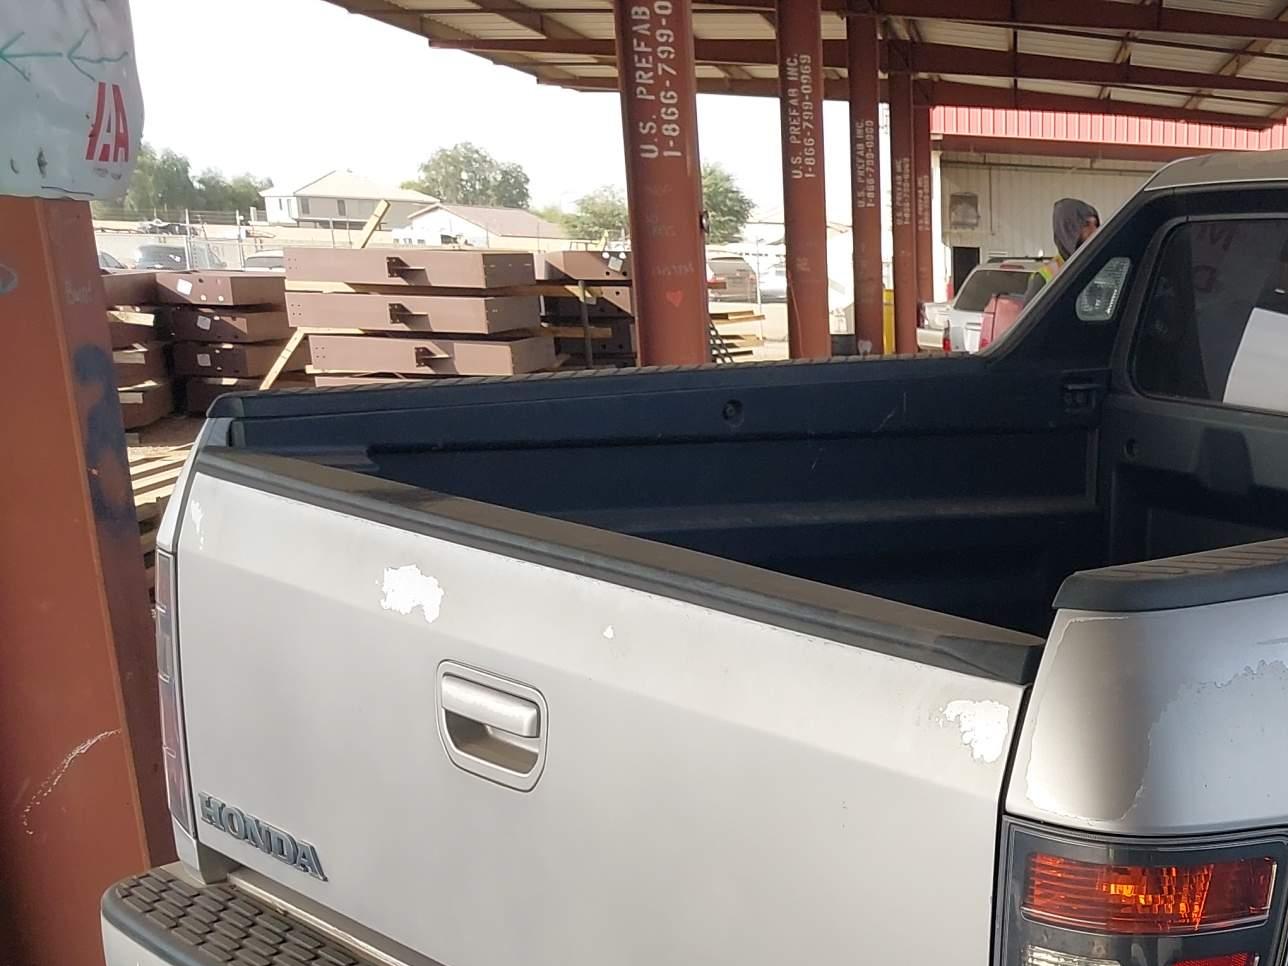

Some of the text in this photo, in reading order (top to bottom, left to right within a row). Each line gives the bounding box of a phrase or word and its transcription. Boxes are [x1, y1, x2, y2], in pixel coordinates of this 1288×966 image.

[631, 6, 656, 100] PREFAB
[638, 114, 659, 158] U.S.
[199, 792, 328, 882] HONDA
